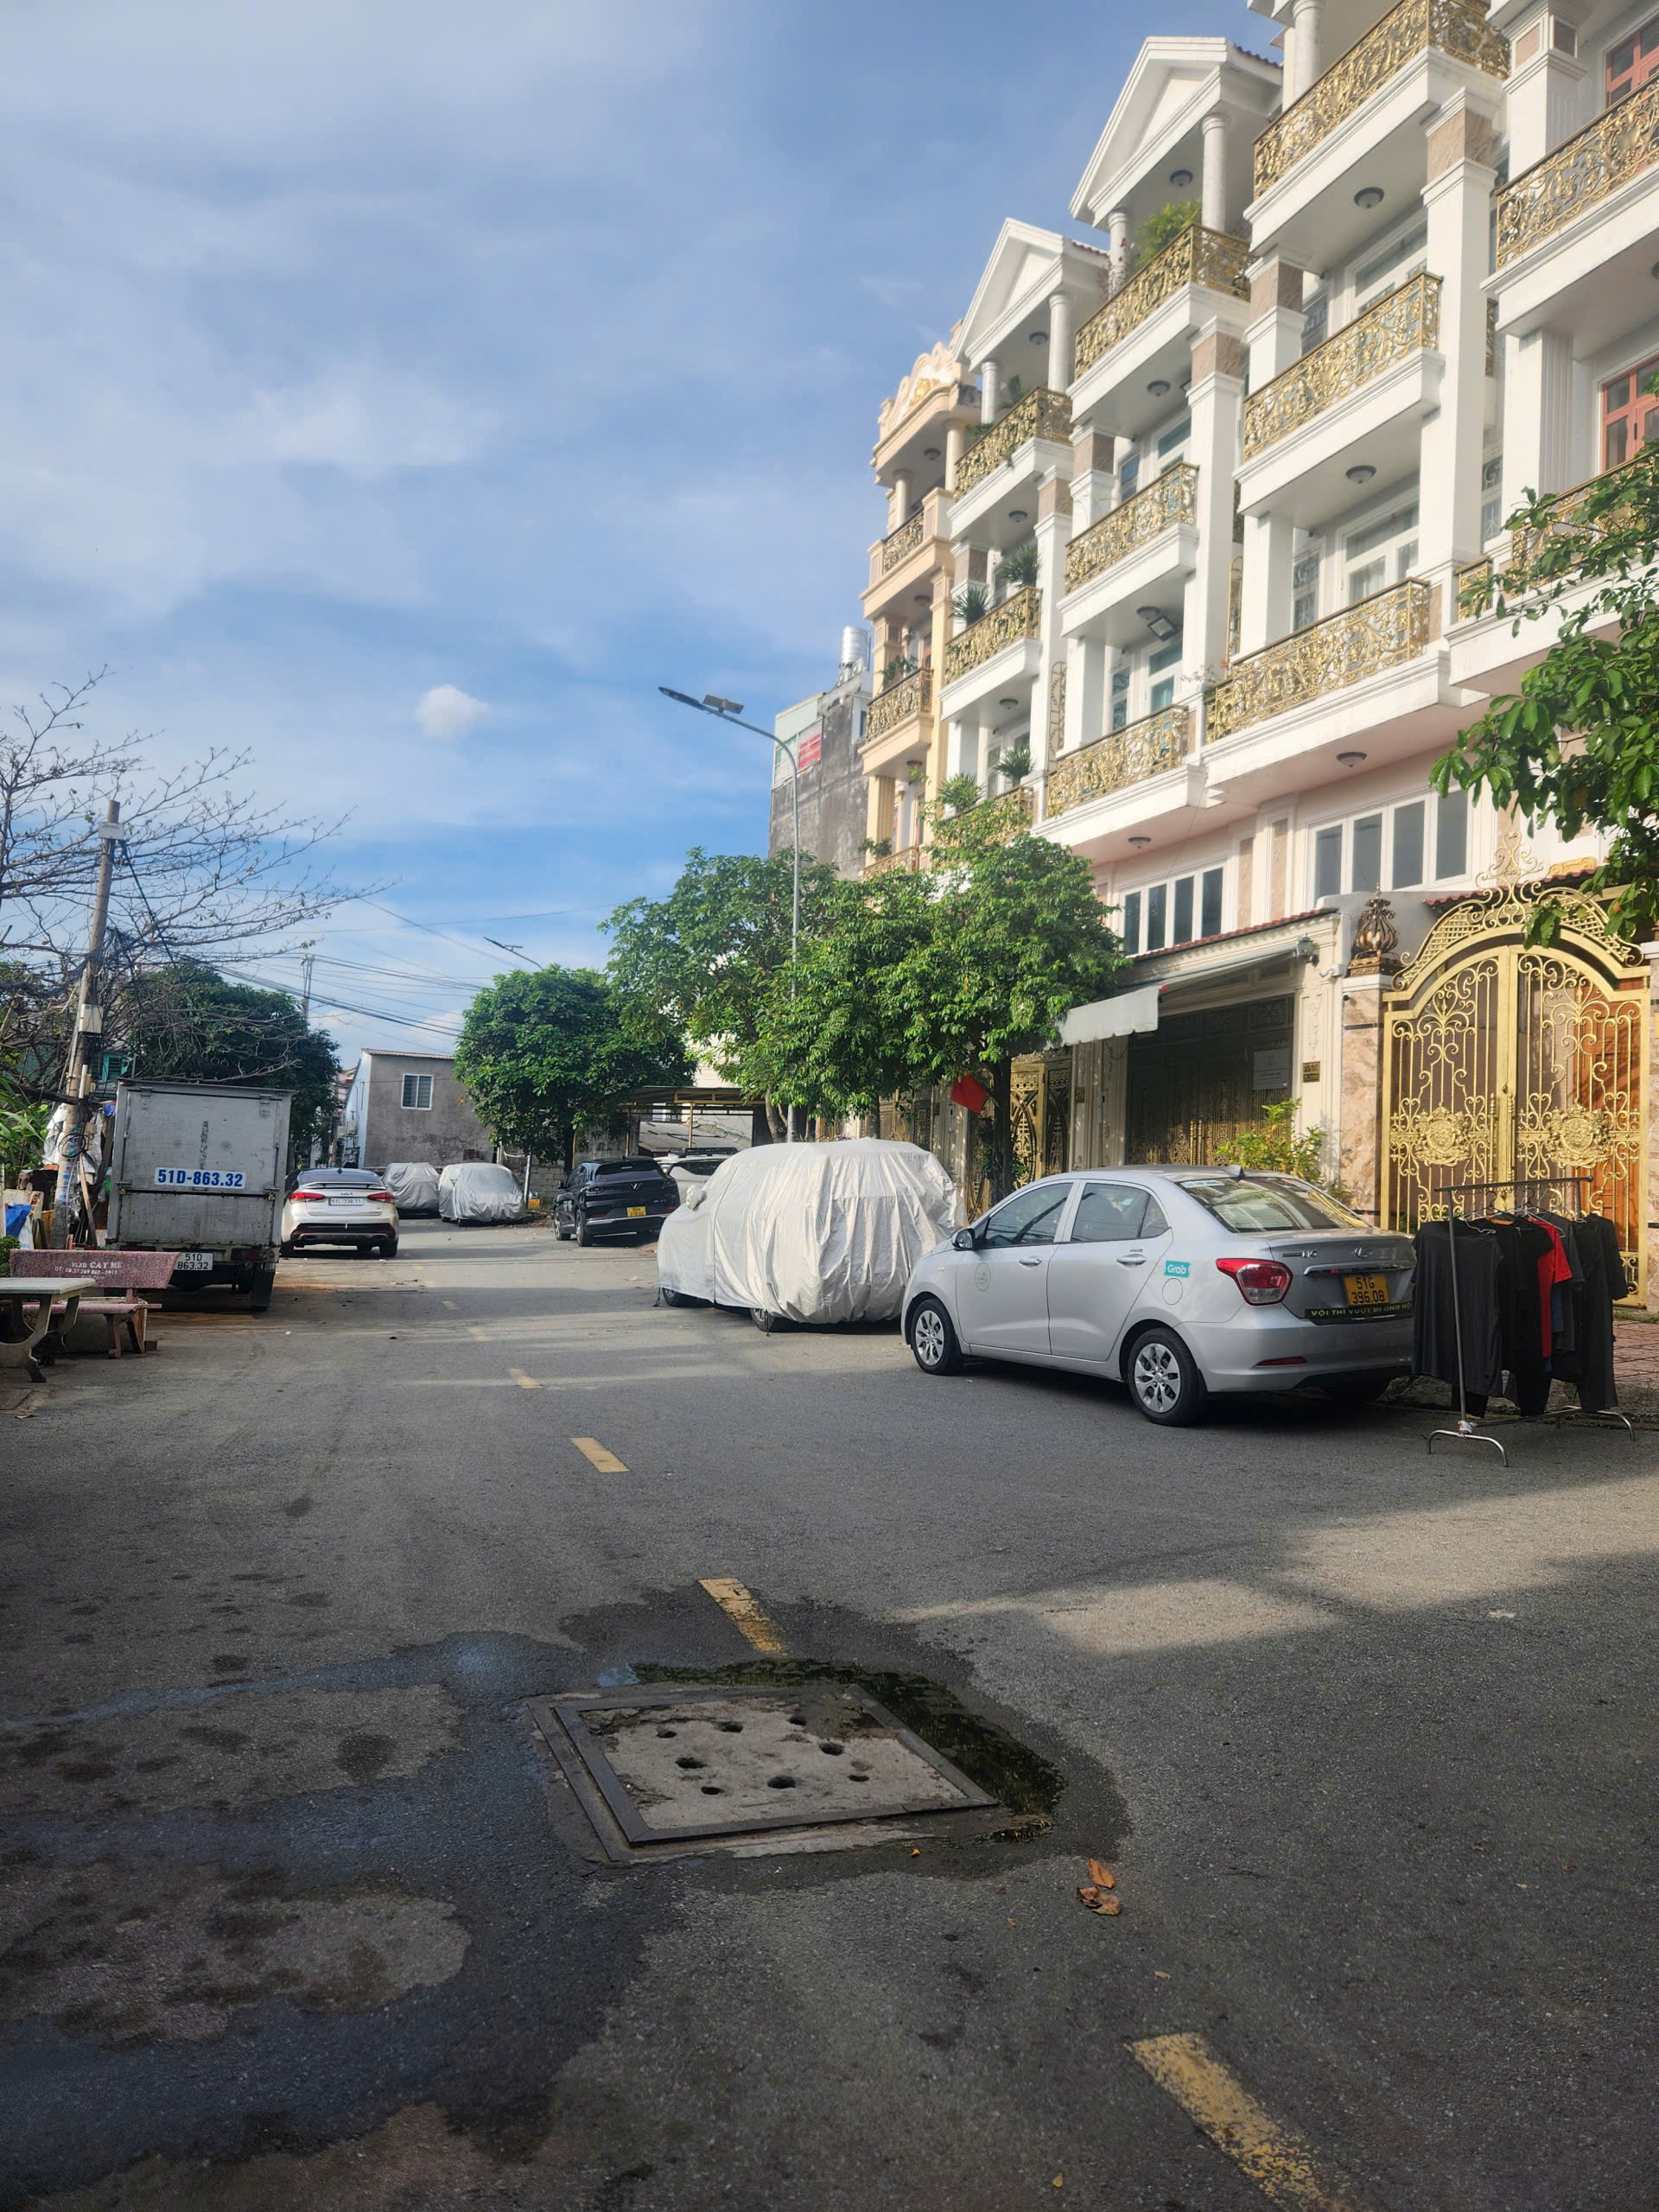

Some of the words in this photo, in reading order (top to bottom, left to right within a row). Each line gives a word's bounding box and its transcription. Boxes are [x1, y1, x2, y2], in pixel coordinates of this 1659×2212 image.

[157, 1169, 243, 1187] 51D-863.32
[1167, 1264, 1186, 1274] Grab
[1356, 1277, 1375, 1289] 51G
[1351, 1290, 1385, 1303] 396.08
